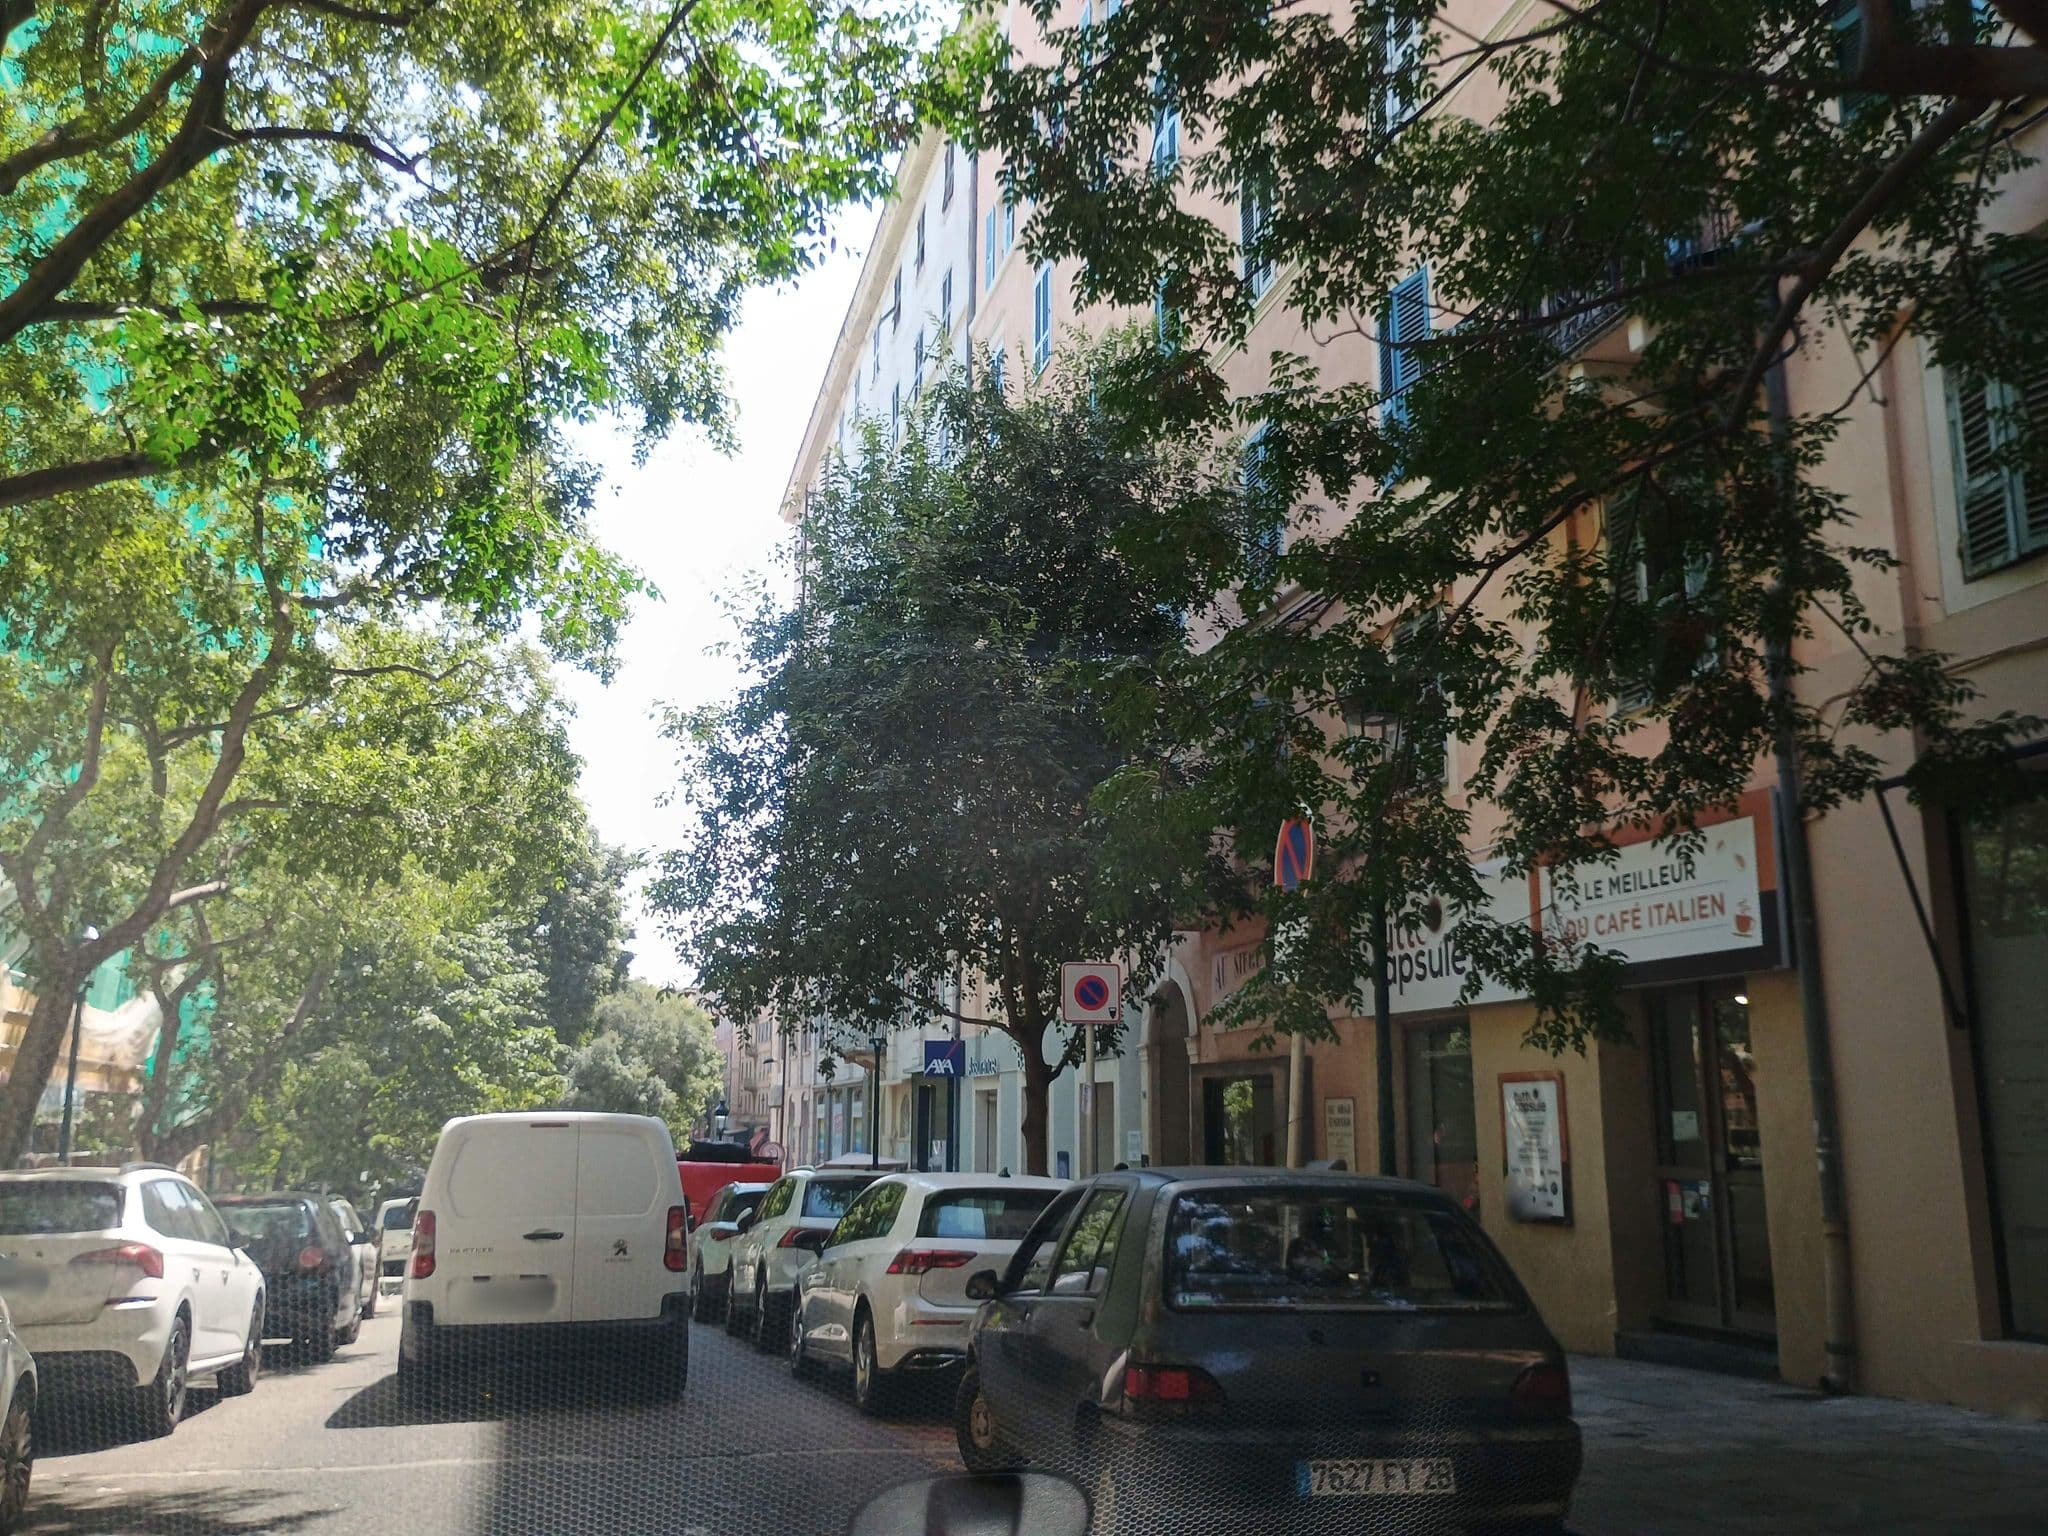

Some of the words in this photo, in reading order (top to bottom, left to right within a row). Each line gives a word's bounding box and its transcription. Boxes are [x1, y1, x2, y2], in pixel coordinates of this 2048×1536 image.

[1584, 879, 1603, 901] LE
[1608, 860, 1697, 896] MEILLEUR
[1595, 902, 1642, 936] CAFÉ
[1647, 892, 1726, 927] ITALIEN
[1385, 933, 1467, 995] apsule
[924, 1059, 955, 1076] AXA
